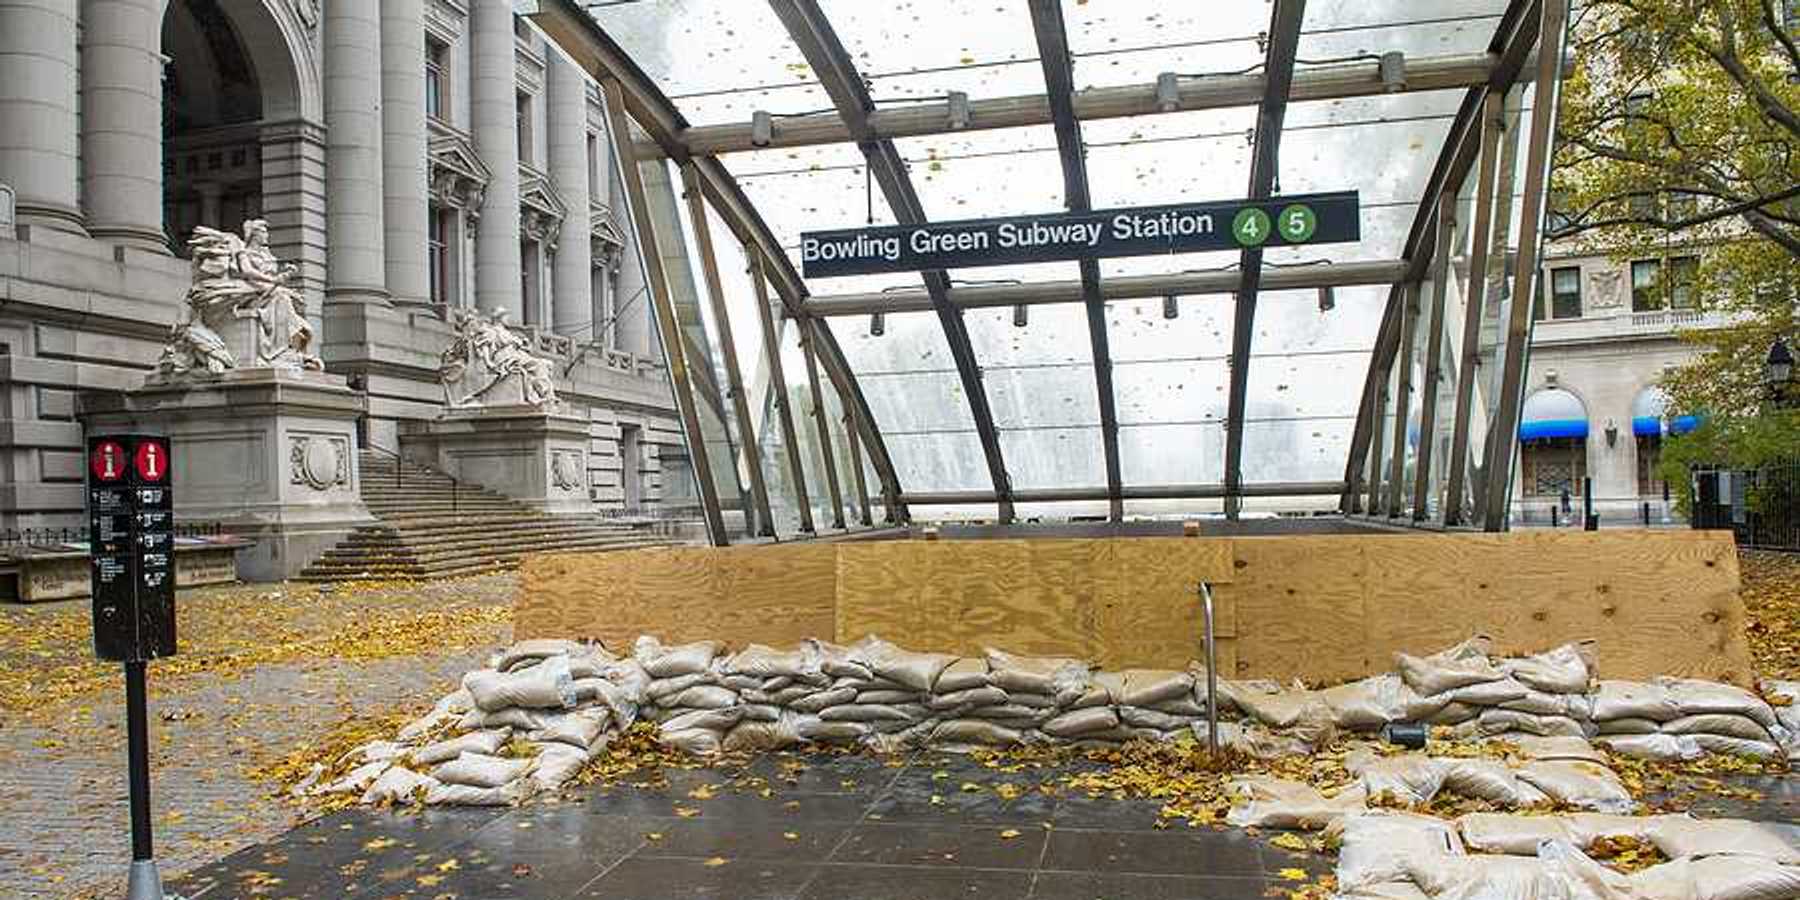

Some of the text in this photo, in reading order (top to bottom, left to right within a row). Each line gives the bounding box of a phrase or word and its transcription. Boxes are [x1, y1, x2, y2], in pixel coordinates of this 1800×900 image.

[802, 211, 1306, 261] Bowling Green Subway Station 4 5
